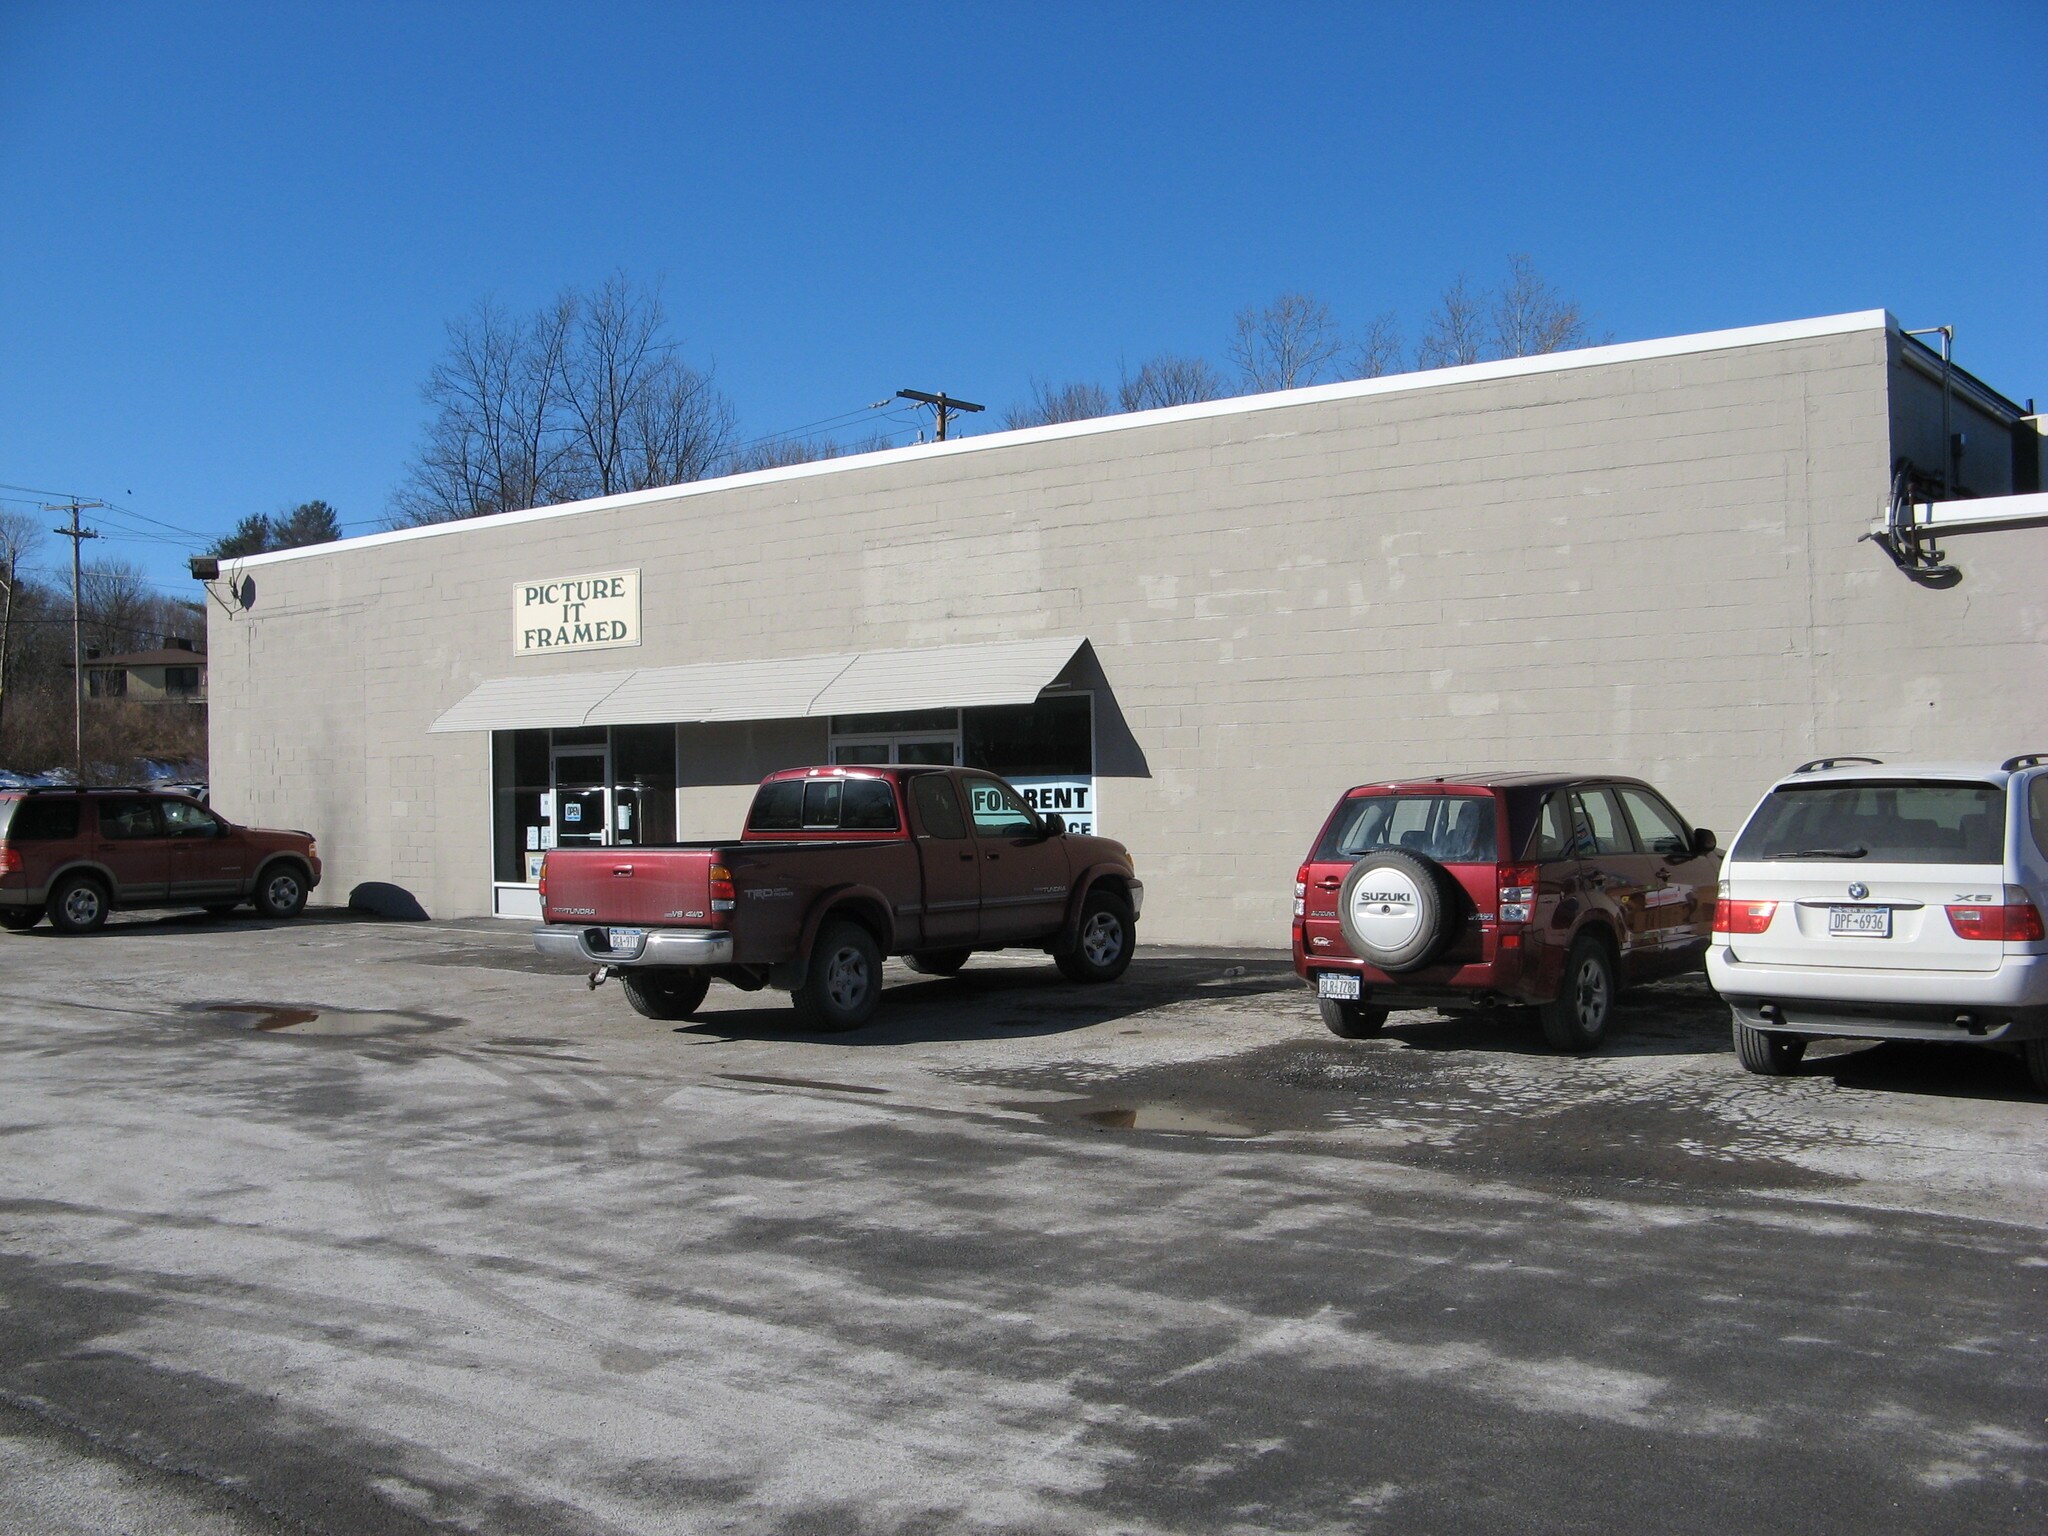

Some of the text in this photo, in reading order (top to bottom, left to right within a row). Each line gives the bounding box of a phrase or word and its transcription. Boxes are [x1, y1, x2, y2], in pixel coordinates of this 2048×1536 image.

[525, 577, 626, 606] PICTURE
[562, 602, 586, 623] IT
[524, 620, 627, 648] FRAMED
[1023, 787, 1089, 809] RENT
[567, 806, 580, 816] OPEN
[743, 888, 773, 900] TRD
[1361, 892, 1410, 901] SUZUKI
[1953, 894, 1992, 902] X5
[565, 907, 596, 915] TUNDRA
[671, 910, 683, 918] V8
[685, 910, 704, 918] 4WD
